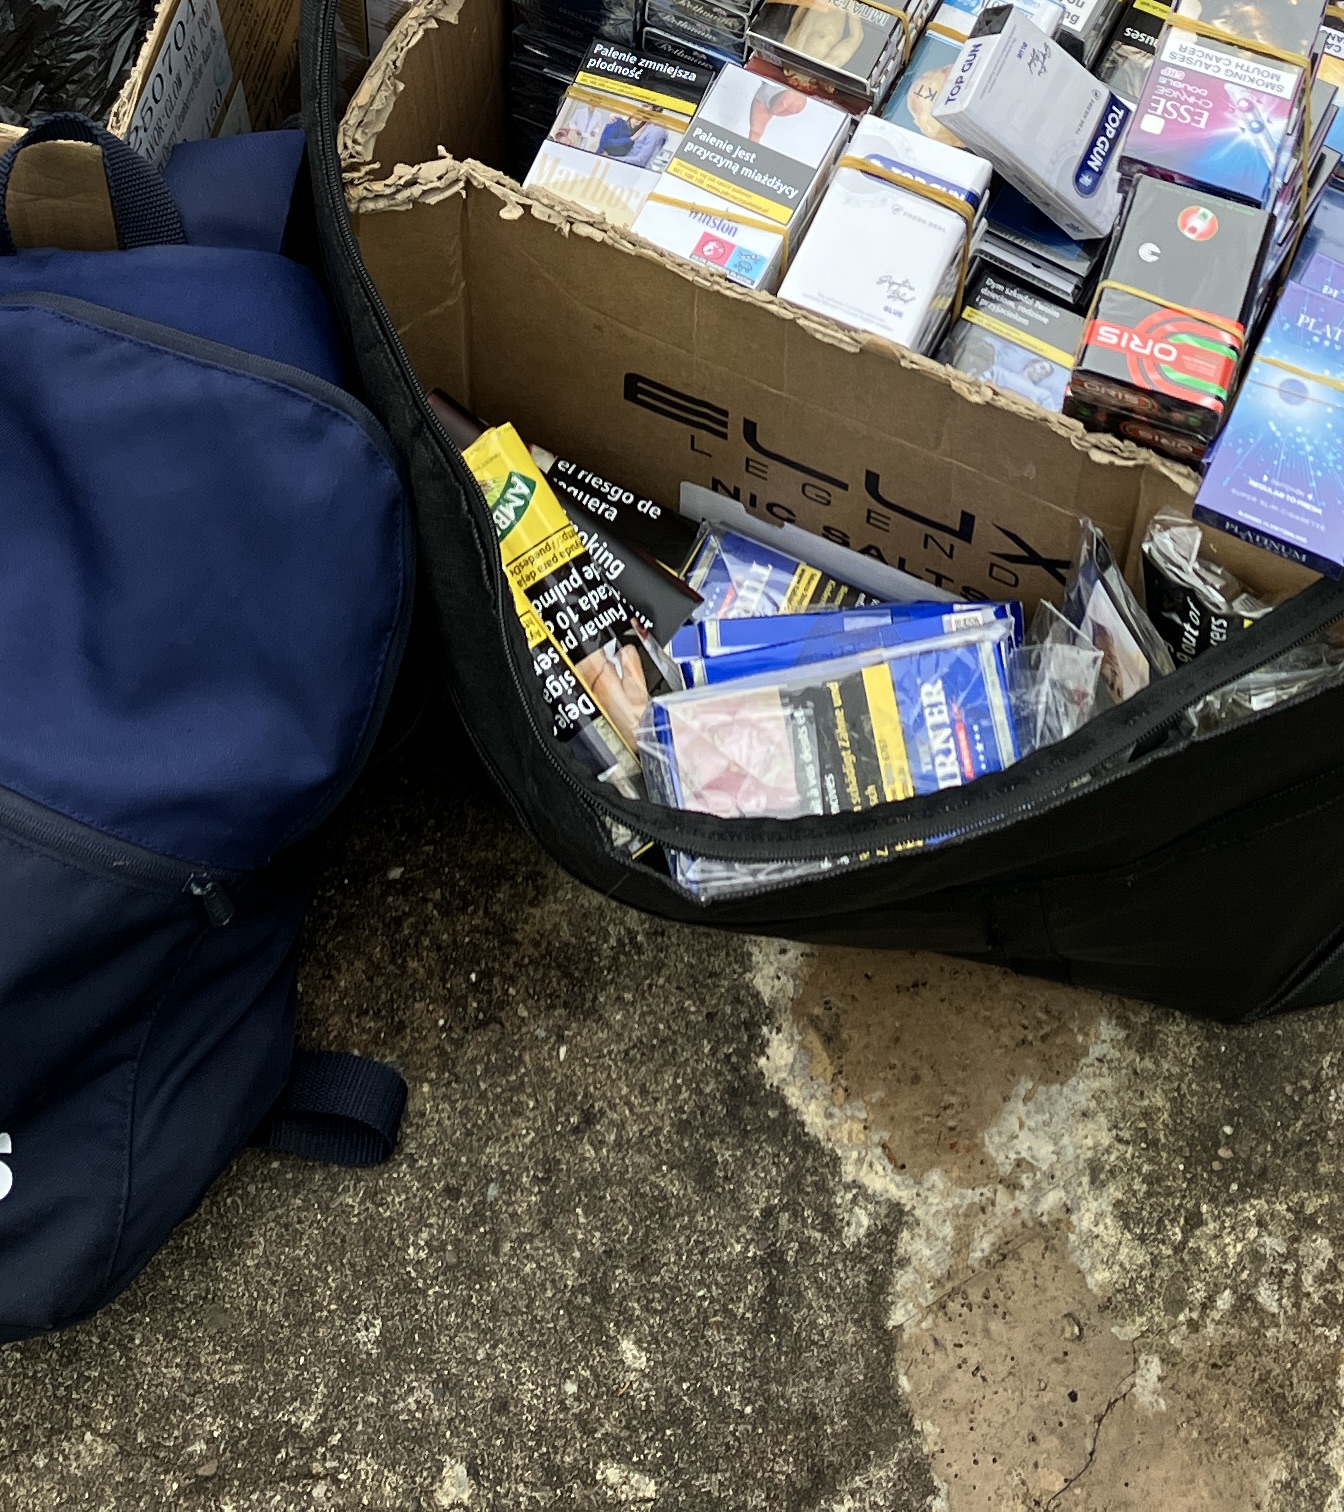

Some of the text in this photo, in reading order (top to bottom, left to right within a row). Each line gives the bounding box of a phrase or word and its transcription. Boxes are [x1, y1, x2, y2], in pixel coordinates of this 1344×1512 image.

[587, 56, 644, 80] płodność
[594, 43, 697, 83] Palenie zmniejsza
[1017, 42, 1027, 60] BLUE
[1178, 44, 1281, 81] MOUTH CANCER
[945, 42, 983, 105] TOP GUN
[1157, 77, 1208, 95] DOUBLE
[1168, 51, 1285, 92] SMOKING CAUSES
[1147, 94, 1209, 129] ESSE
[1156, 85, 1213, 109] CHANGE
[692, 127, 757, 164] Palenie jest
[1087, 105, 1124, 172] TOP GUN
[684, 141, 800, 200] przyczyną miażdżycy
[986, 277, 1004, 291] Dym
[1004, 287, 1034, 304] szkodzi
[883, 305, 903, 318] BLUE
[1016, 305, 1049, 324] rodzinie
[1097, 326, 1177, 362] ORIS
[557, 459, 576, 473] el
[577, 470, 634, 505] riesgo
[637, 499, 662, 520] de
[623, 372, 1073, 586] ELUX
[689, 434, 1020, 589] LEGEND
[711, 476, 989, 602] NIC SALTS
[1224, 521, 1307, 563] PLATINUM
[557, 608, 579, 629] 10
[1182, 622, 1199, 655] out
